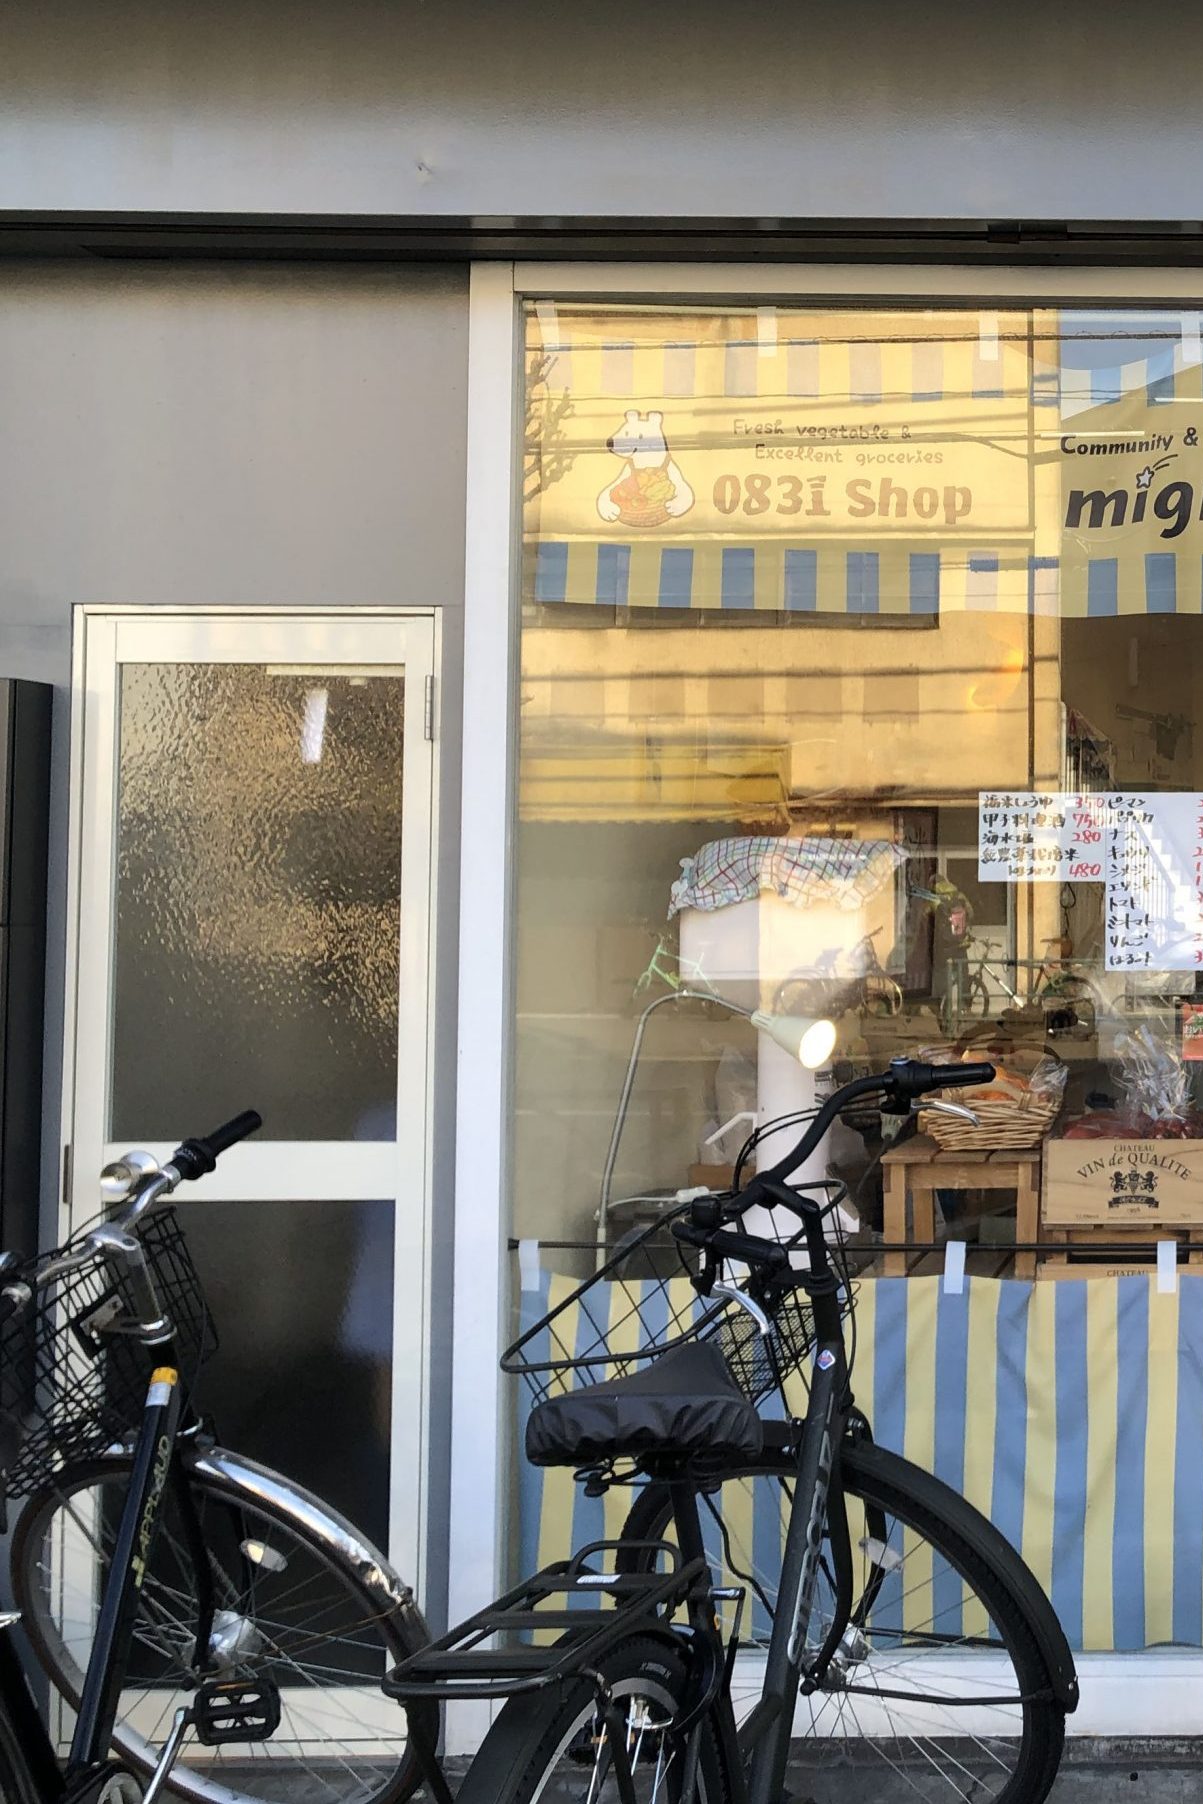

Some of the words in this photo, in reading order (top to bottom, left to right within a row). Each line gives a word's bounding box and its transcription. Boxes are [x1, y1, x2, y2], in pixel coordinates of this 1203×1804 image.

[733, 418, 785, 435] Fresh
[796, 424, 889, 440] vegetable
[901, 425, 912, 439] &
[1060, 433, 1174, 456] Community
[1183, 427, 1198, 447] &
[755, 443, 843, 463] Excellent
[855, 450, 944, 466] groceries
[845, 477, 973, 525] Shop
[1072, 830, 1102, 844] 280
[1069, 863, 1102, 877] 480
[1113, 1144, 1155, 1153] CHATEAU
[1076, 1157, 1106, 1179] VIN
[1108, 1152, 1124, 1167] de
[1127, 1152, 1193, 1181] QUALITE
